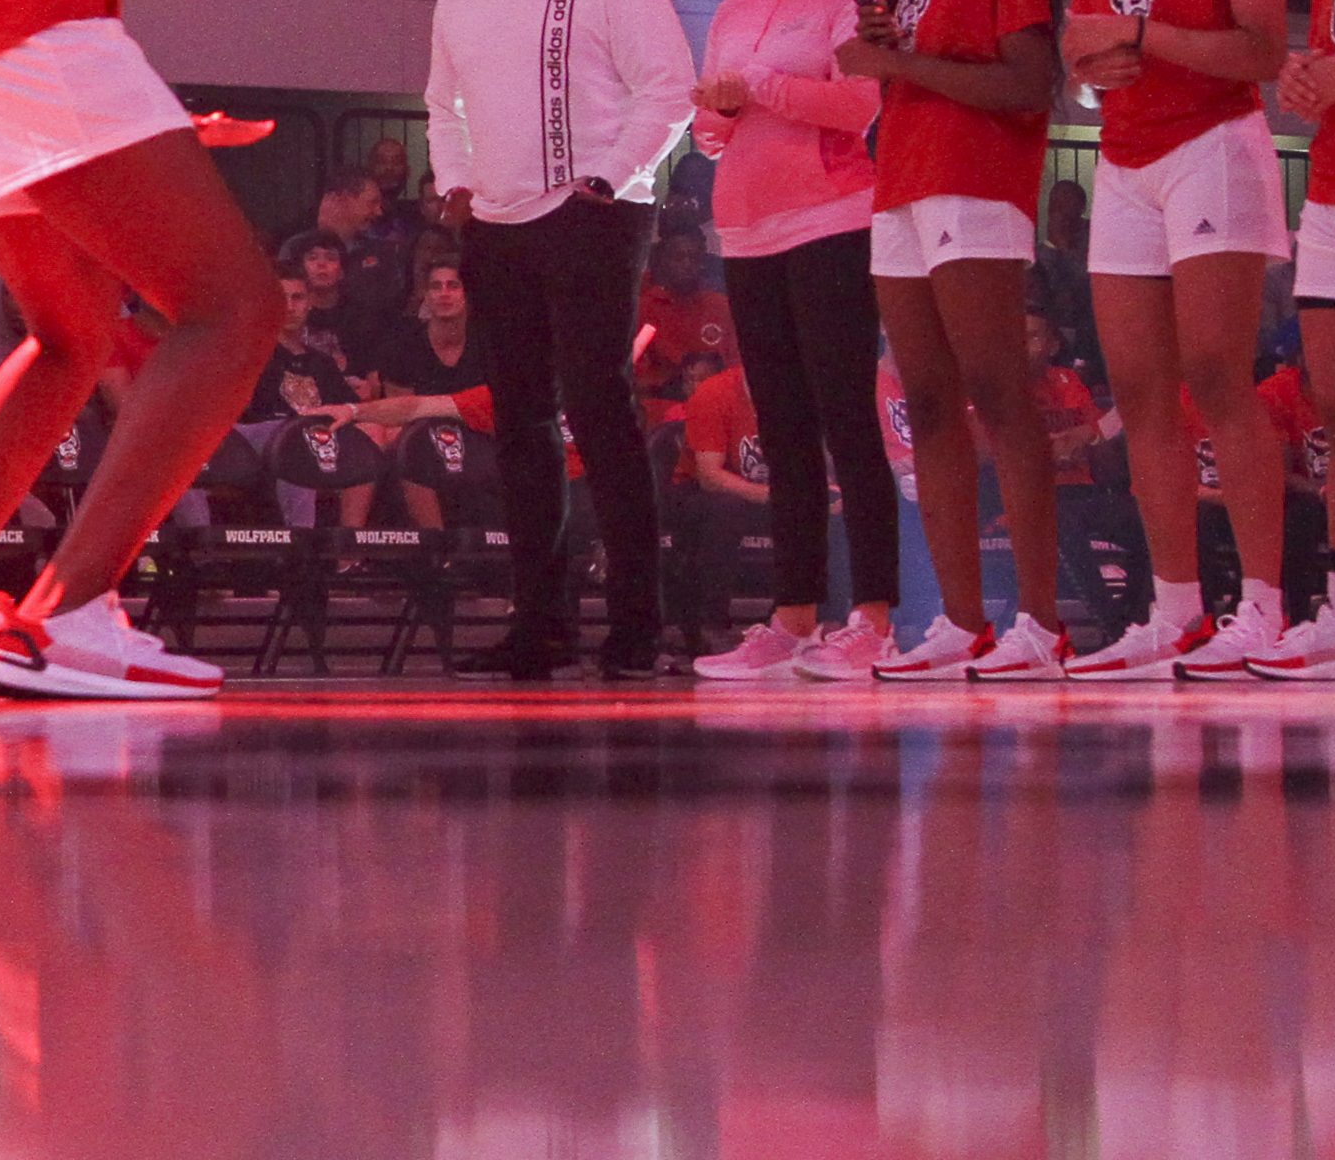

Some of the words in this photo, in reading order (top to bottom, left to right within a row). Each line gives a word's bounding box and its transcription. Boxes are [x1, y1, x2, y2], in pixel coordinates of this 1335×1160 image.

[547, 27, 564, 90] adidas
[549, 97, 565, 160] adidas
[225, 530, 292, 544] WOLFPACK
[355, 530, 420, 545] WOLFPACK
